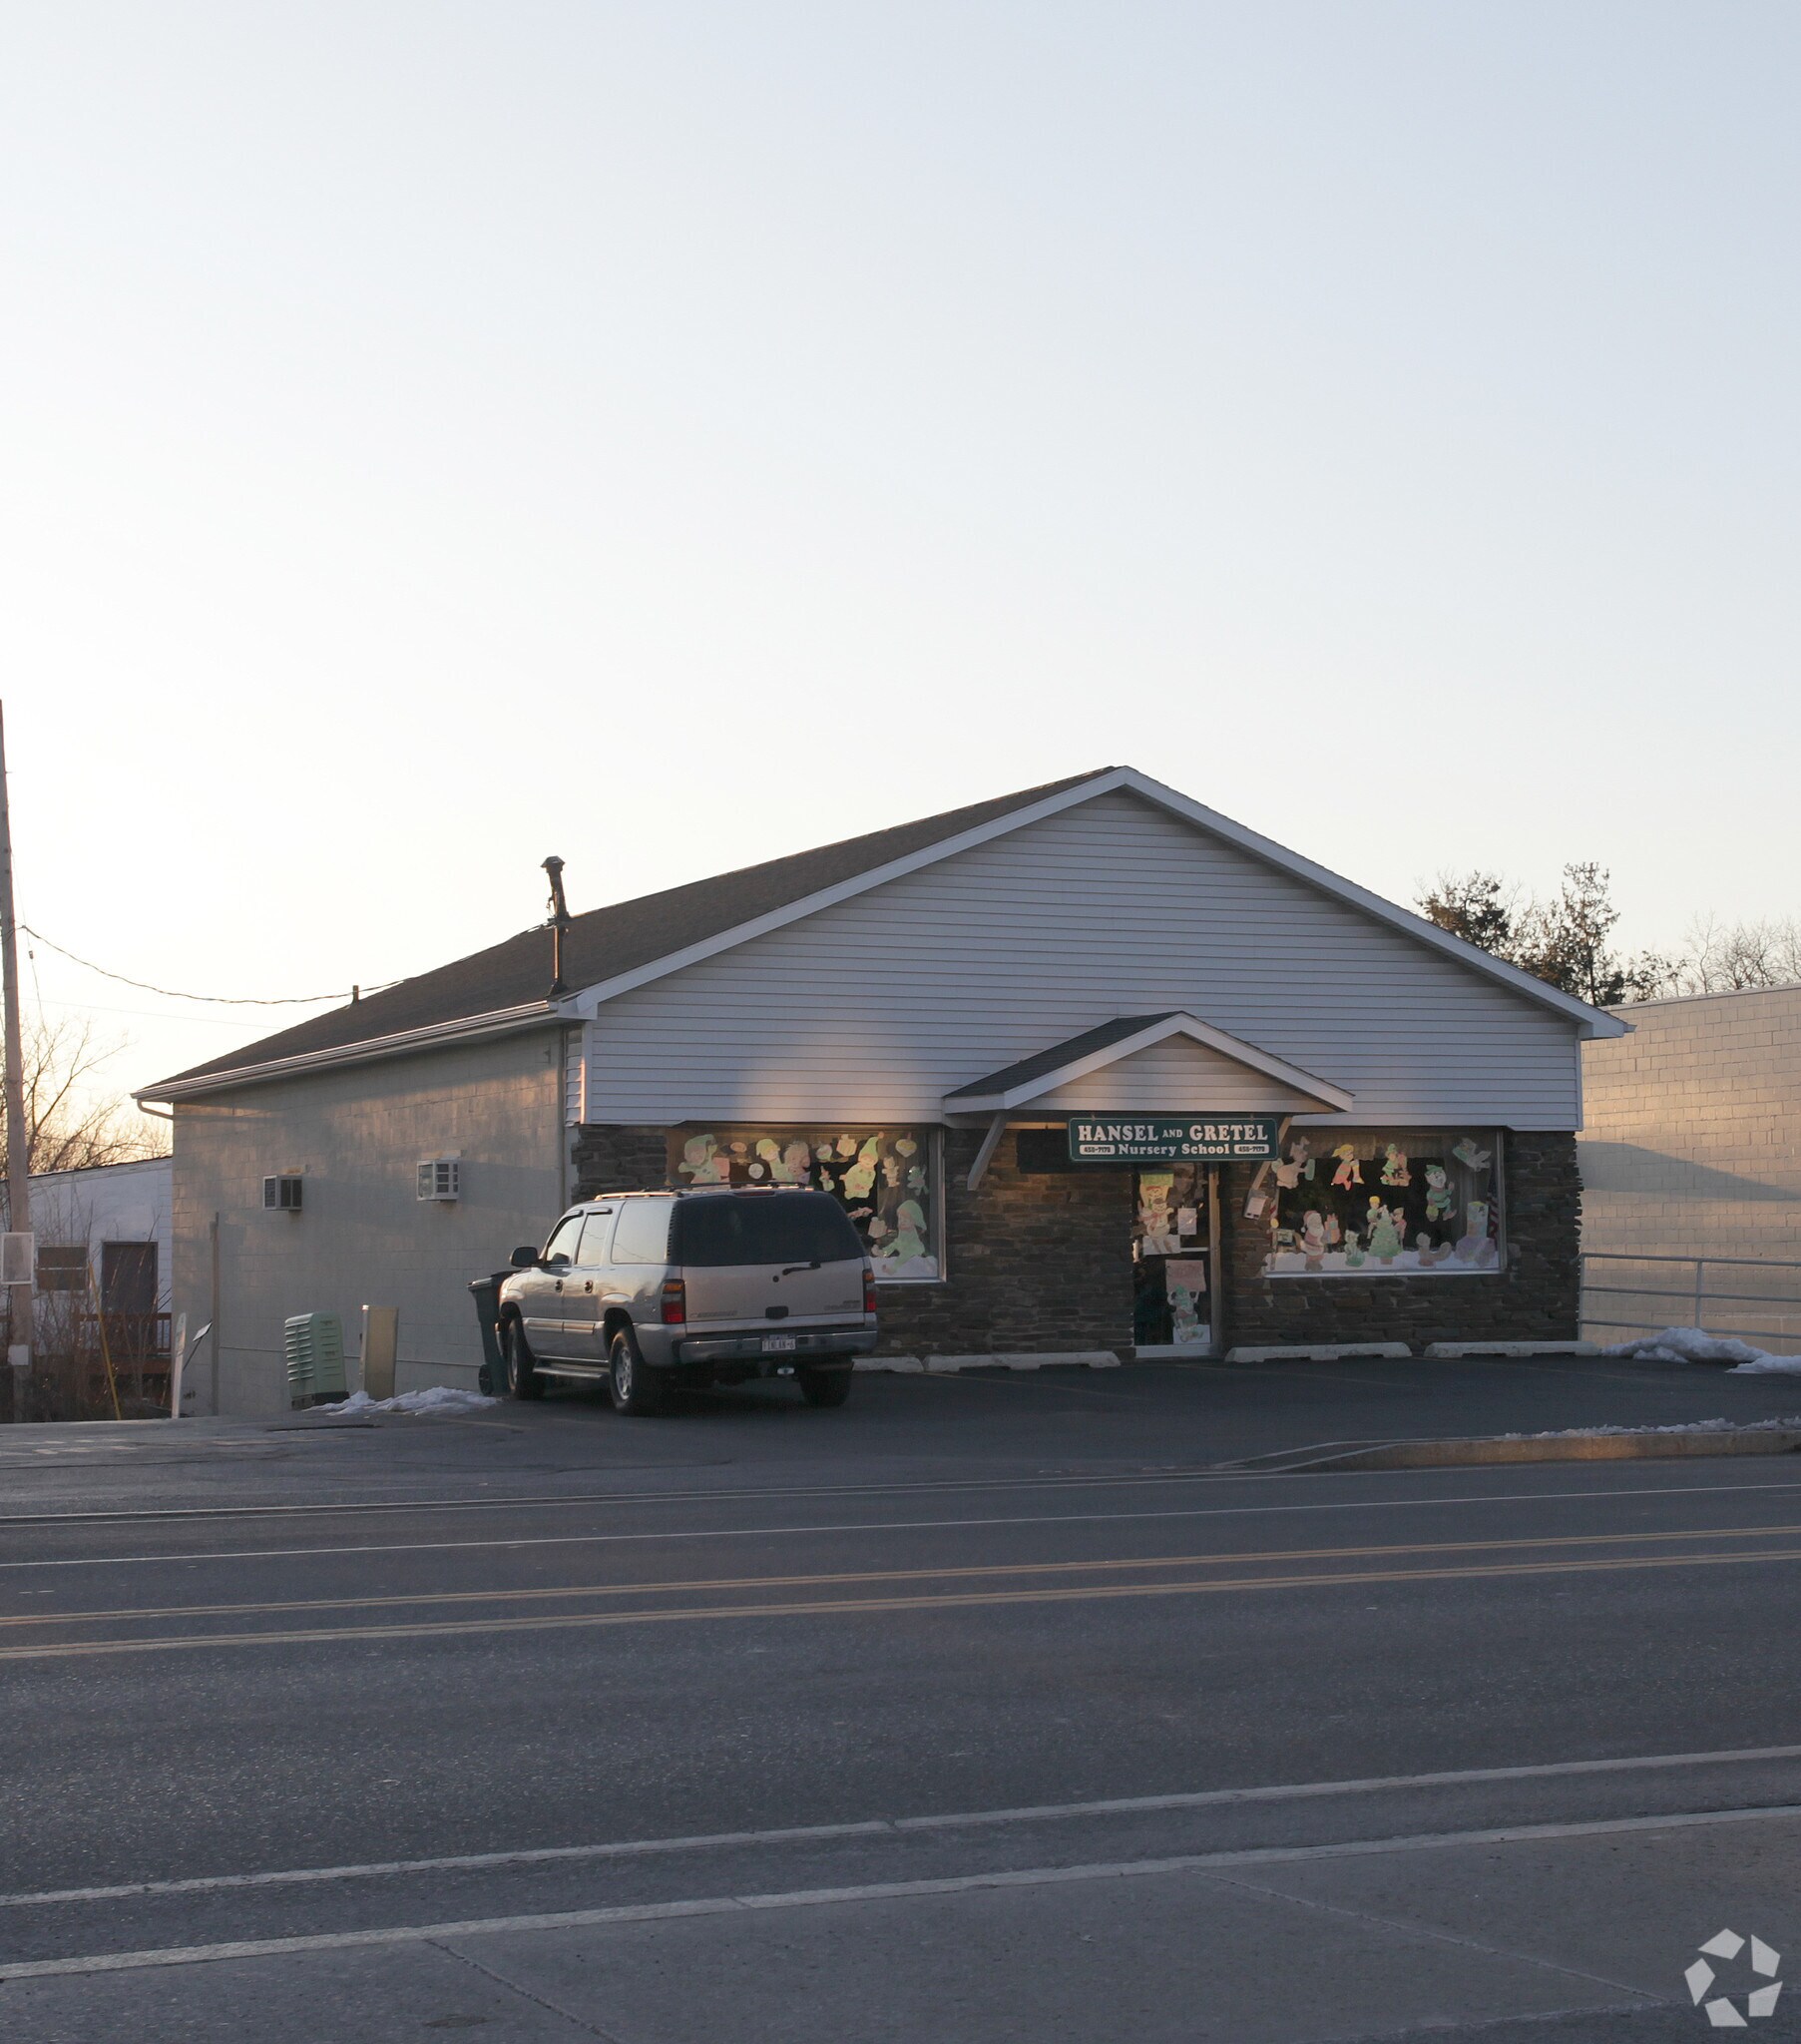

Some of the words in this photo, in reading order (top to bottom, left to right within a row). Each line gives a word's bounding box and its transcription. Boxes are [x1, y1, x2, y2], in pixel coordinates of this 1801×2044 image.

[1078, 1125, 1158, 1141] HANSEL
[1162, 1129, 1183, 1138] AND
[1189, 1124, 1268, 1141] GRETEL
[1118, 1143, 1176, 1157] Nursery
[1181, 1143, 1230, 1155] School
